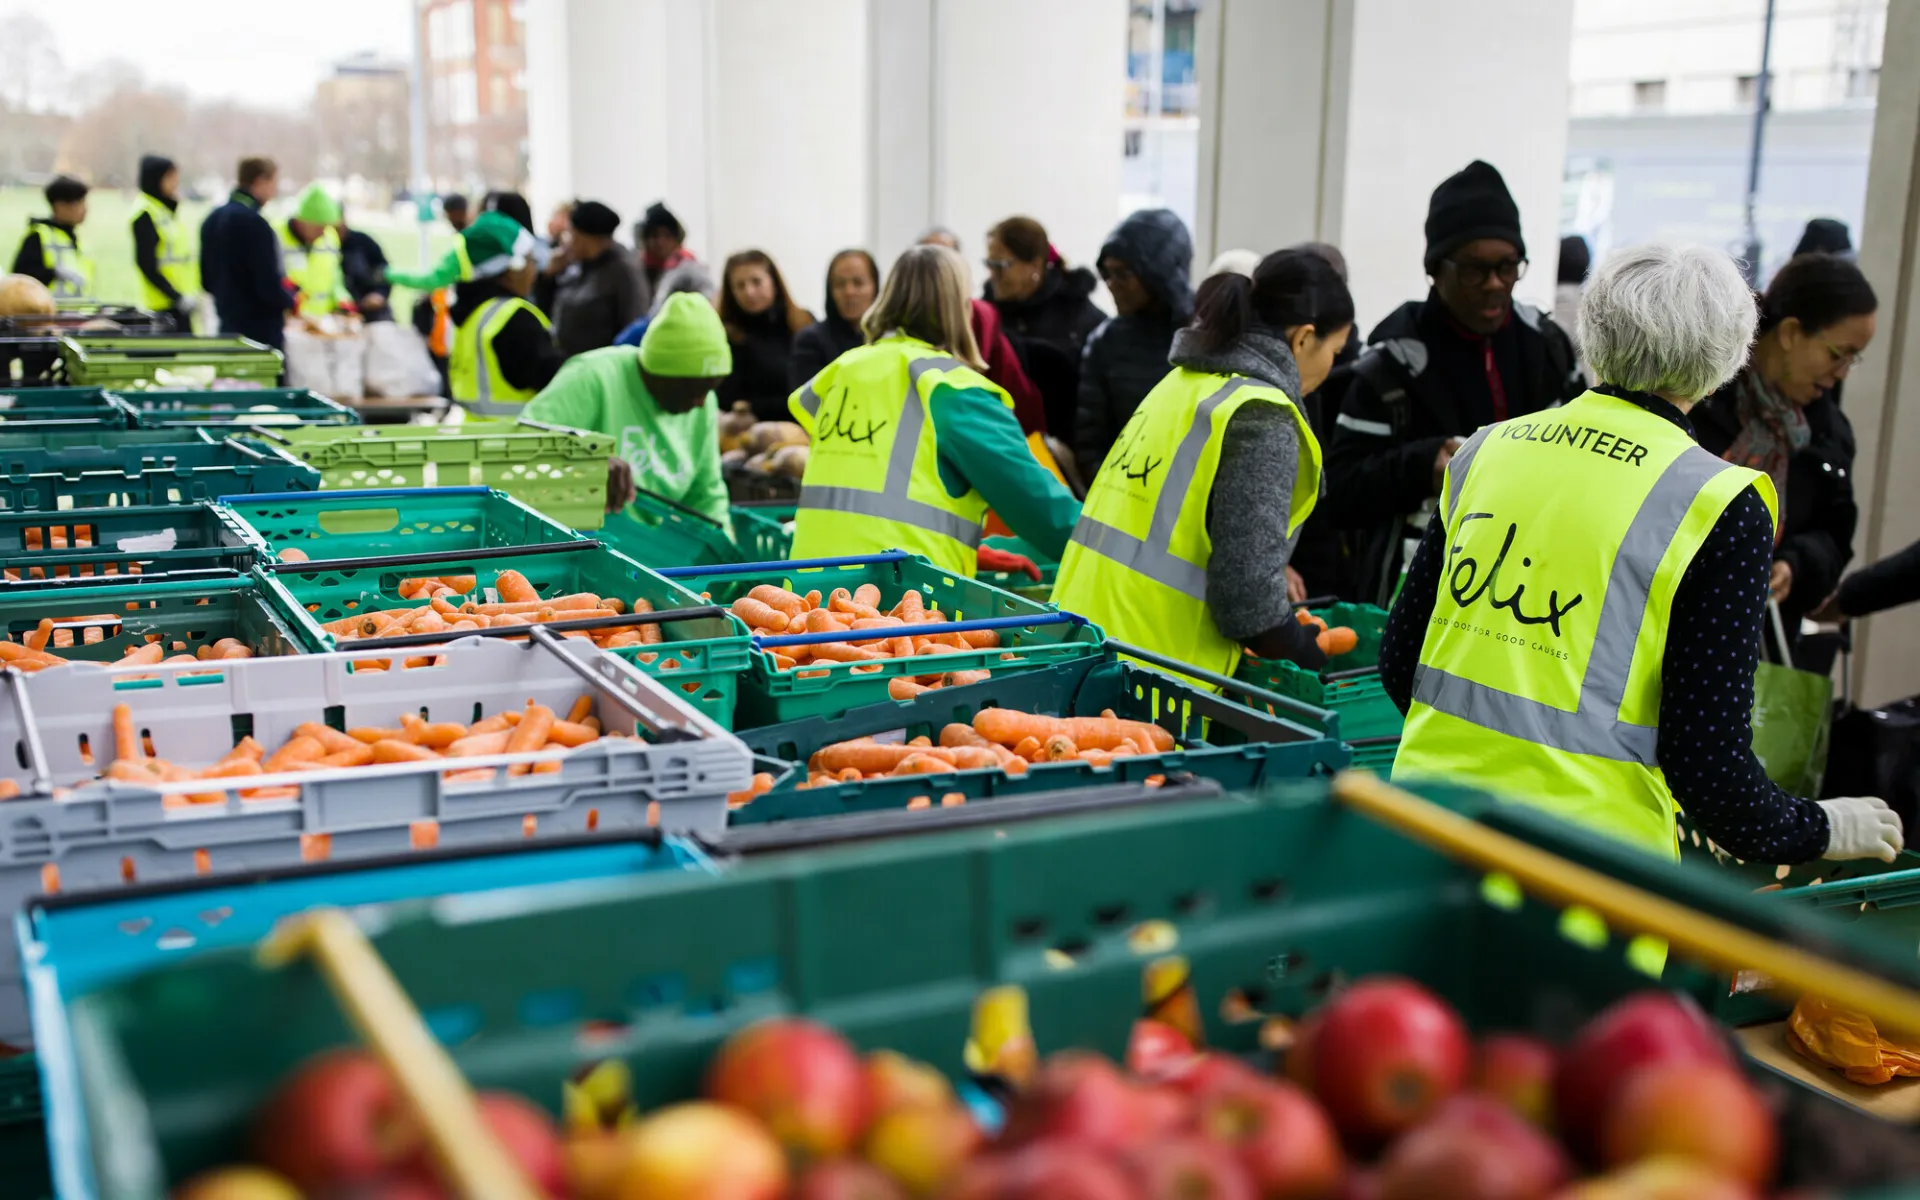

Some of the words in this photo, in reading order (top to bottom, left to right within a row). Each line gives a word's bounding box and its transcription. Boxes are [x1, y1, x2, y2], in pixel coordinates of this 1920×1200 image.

[1500, 423, 1648, 467] VOLUNTEER
[1447, 512, 1583, 638] Felix
[1495, 632, 1526, 647] GOOD
[1531, 642, 1569, 661] CAUSES
